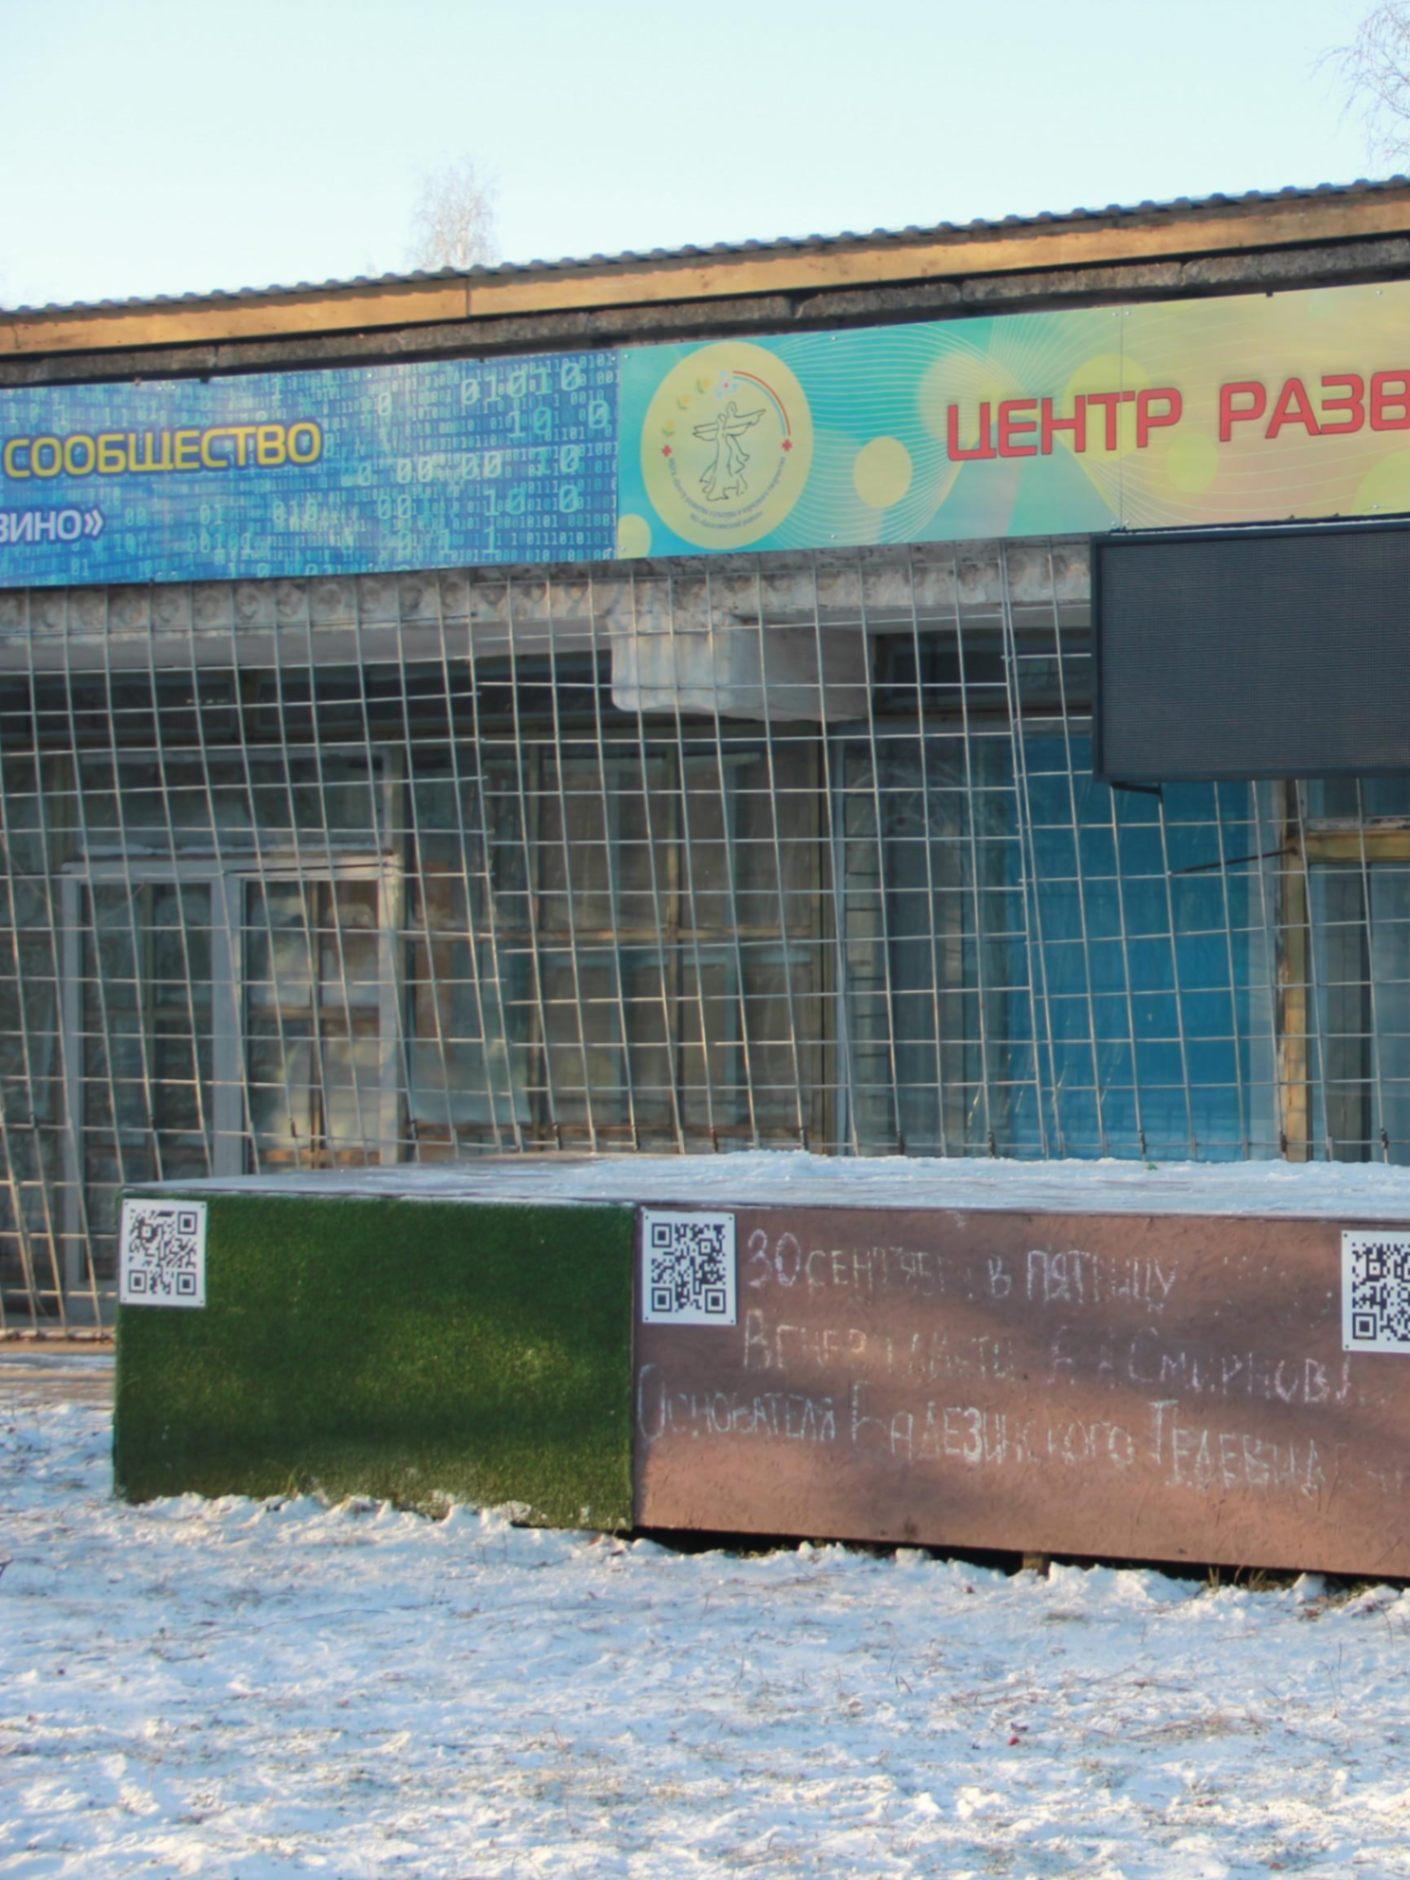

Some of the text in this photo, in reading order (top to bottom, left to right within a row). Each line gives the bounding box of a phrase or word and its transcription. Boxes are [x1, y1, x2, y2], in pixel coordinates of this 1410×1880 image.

[4, 421, 323, 479] СООБЩЕСТВО
[946, 386, 1184, 462] ЦЕНТР
[746, 1228, 801, 1288] 30
